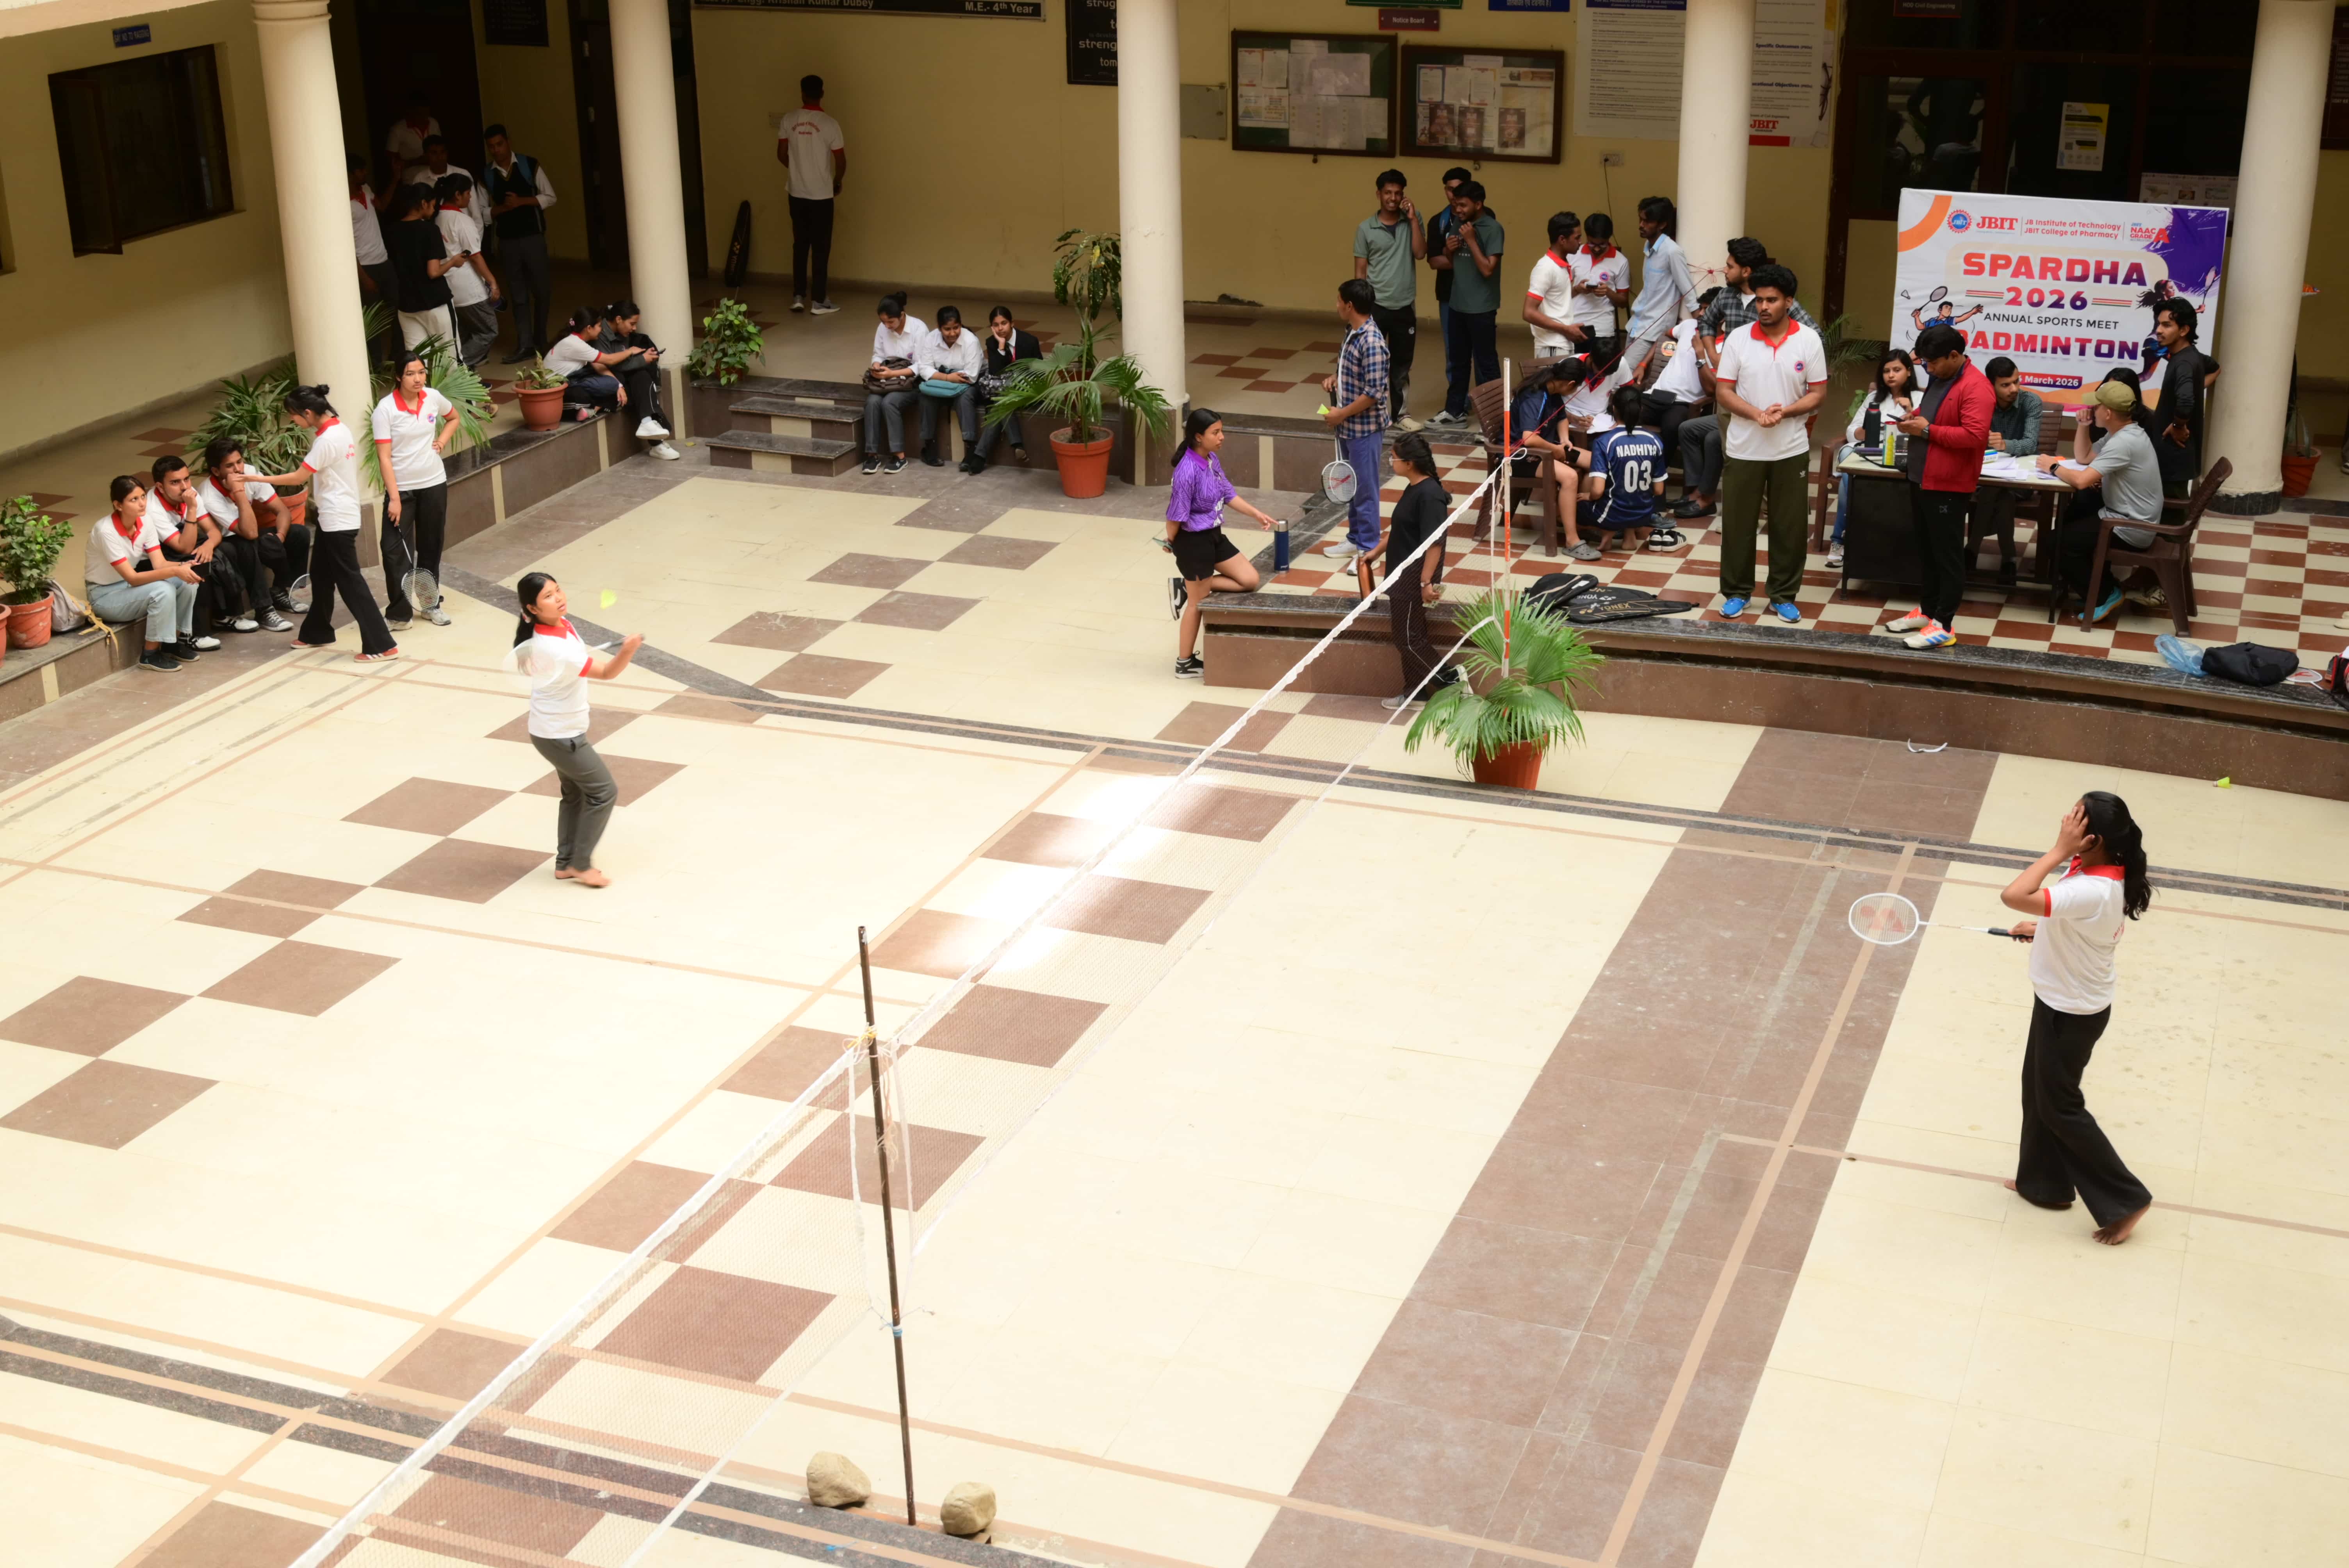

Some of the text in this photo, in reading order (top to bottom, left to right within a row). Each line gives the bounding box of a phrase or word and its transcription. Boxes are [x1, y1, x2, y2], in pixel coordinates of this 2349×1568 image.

[843, 0, 873, 9] Dubey
[993, 2, 1007, 12] 4th
[1010, 4, 1034, 13] Year
[1750, 119, 1779, 129] JBIT
[1976, 216, 2018, 230] JBIT
[2078, 222, 2121, 231] Technology
[2041, 228, 2068, 237] College
[2080, 230, 2118, 239] Pharmacy
[2153, 228, 2170, 244] A
[1963, 252, 2147, 286] SPARDHA
[2005, 287, 2087, 310] 2026
[1984, 313, 2119, 330] ANNUAL SPORTS MEET
[2025, 375, 2053, 385] March
[2055, 378, 2078, 387] 2026
[1616, 444, 1657, 458] NADHIYA
[1624, 460, 1652, 493] 03
[1599, 602, 1631, 611] YONEX
